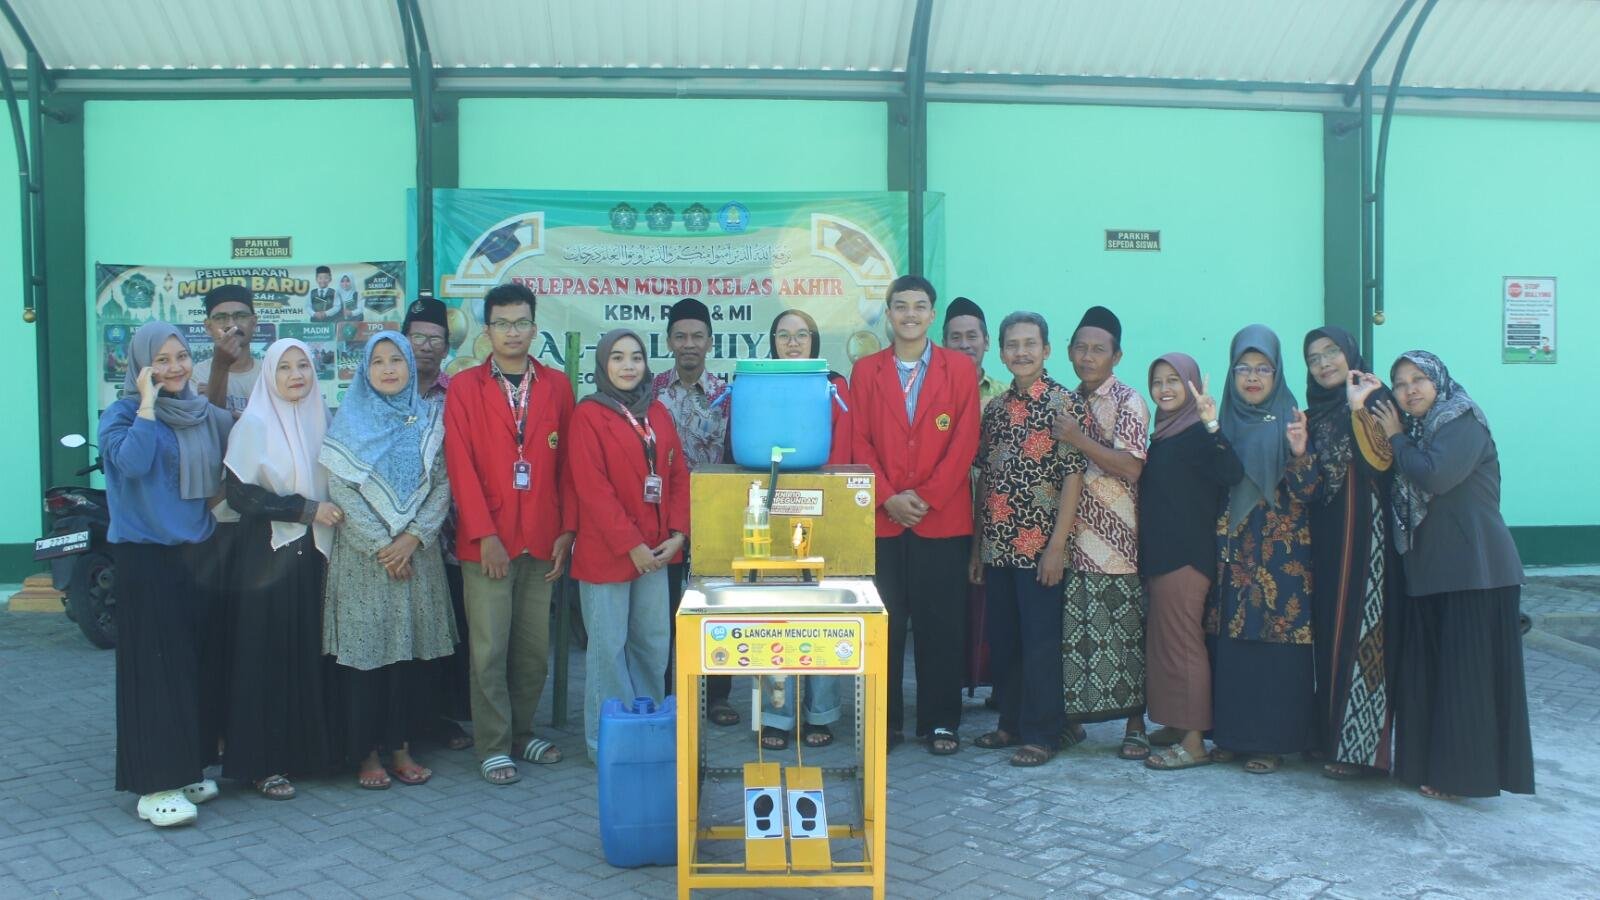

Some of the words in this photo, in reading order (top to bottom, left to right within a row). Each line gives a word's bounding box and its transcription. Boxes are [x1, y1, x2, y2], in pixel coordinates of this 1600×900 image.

[1118, 232, 1150, 240] PARKIR
[245, 239, 279, 247] PARKIR
[1107, 240, 1134, 248] SEPEDA
[1135, 240, 1158, 249] SISWA
[234, 247, 264, 257] SEPEDA
[266, 247, 288, 256] GURU
[251, 277, 310, 297] BARU
[634, 277, 702, 296] MURID
[706, 277, 773, 296] KELAS
[778, 277, 844, 296] AKHIR
[605, 304, 655, 322] KBM,
[711, 304, 723, 321] &
[729, 304, 751, 321] MI
[303, 327, 330, 335] MADIN
[731, 628, 742, 639] 6
[744, 629, 782, 638] LANGKAH
[785, 629, 820, 638] MENCUCI
[823, 629, 854, 638] TANGAN
